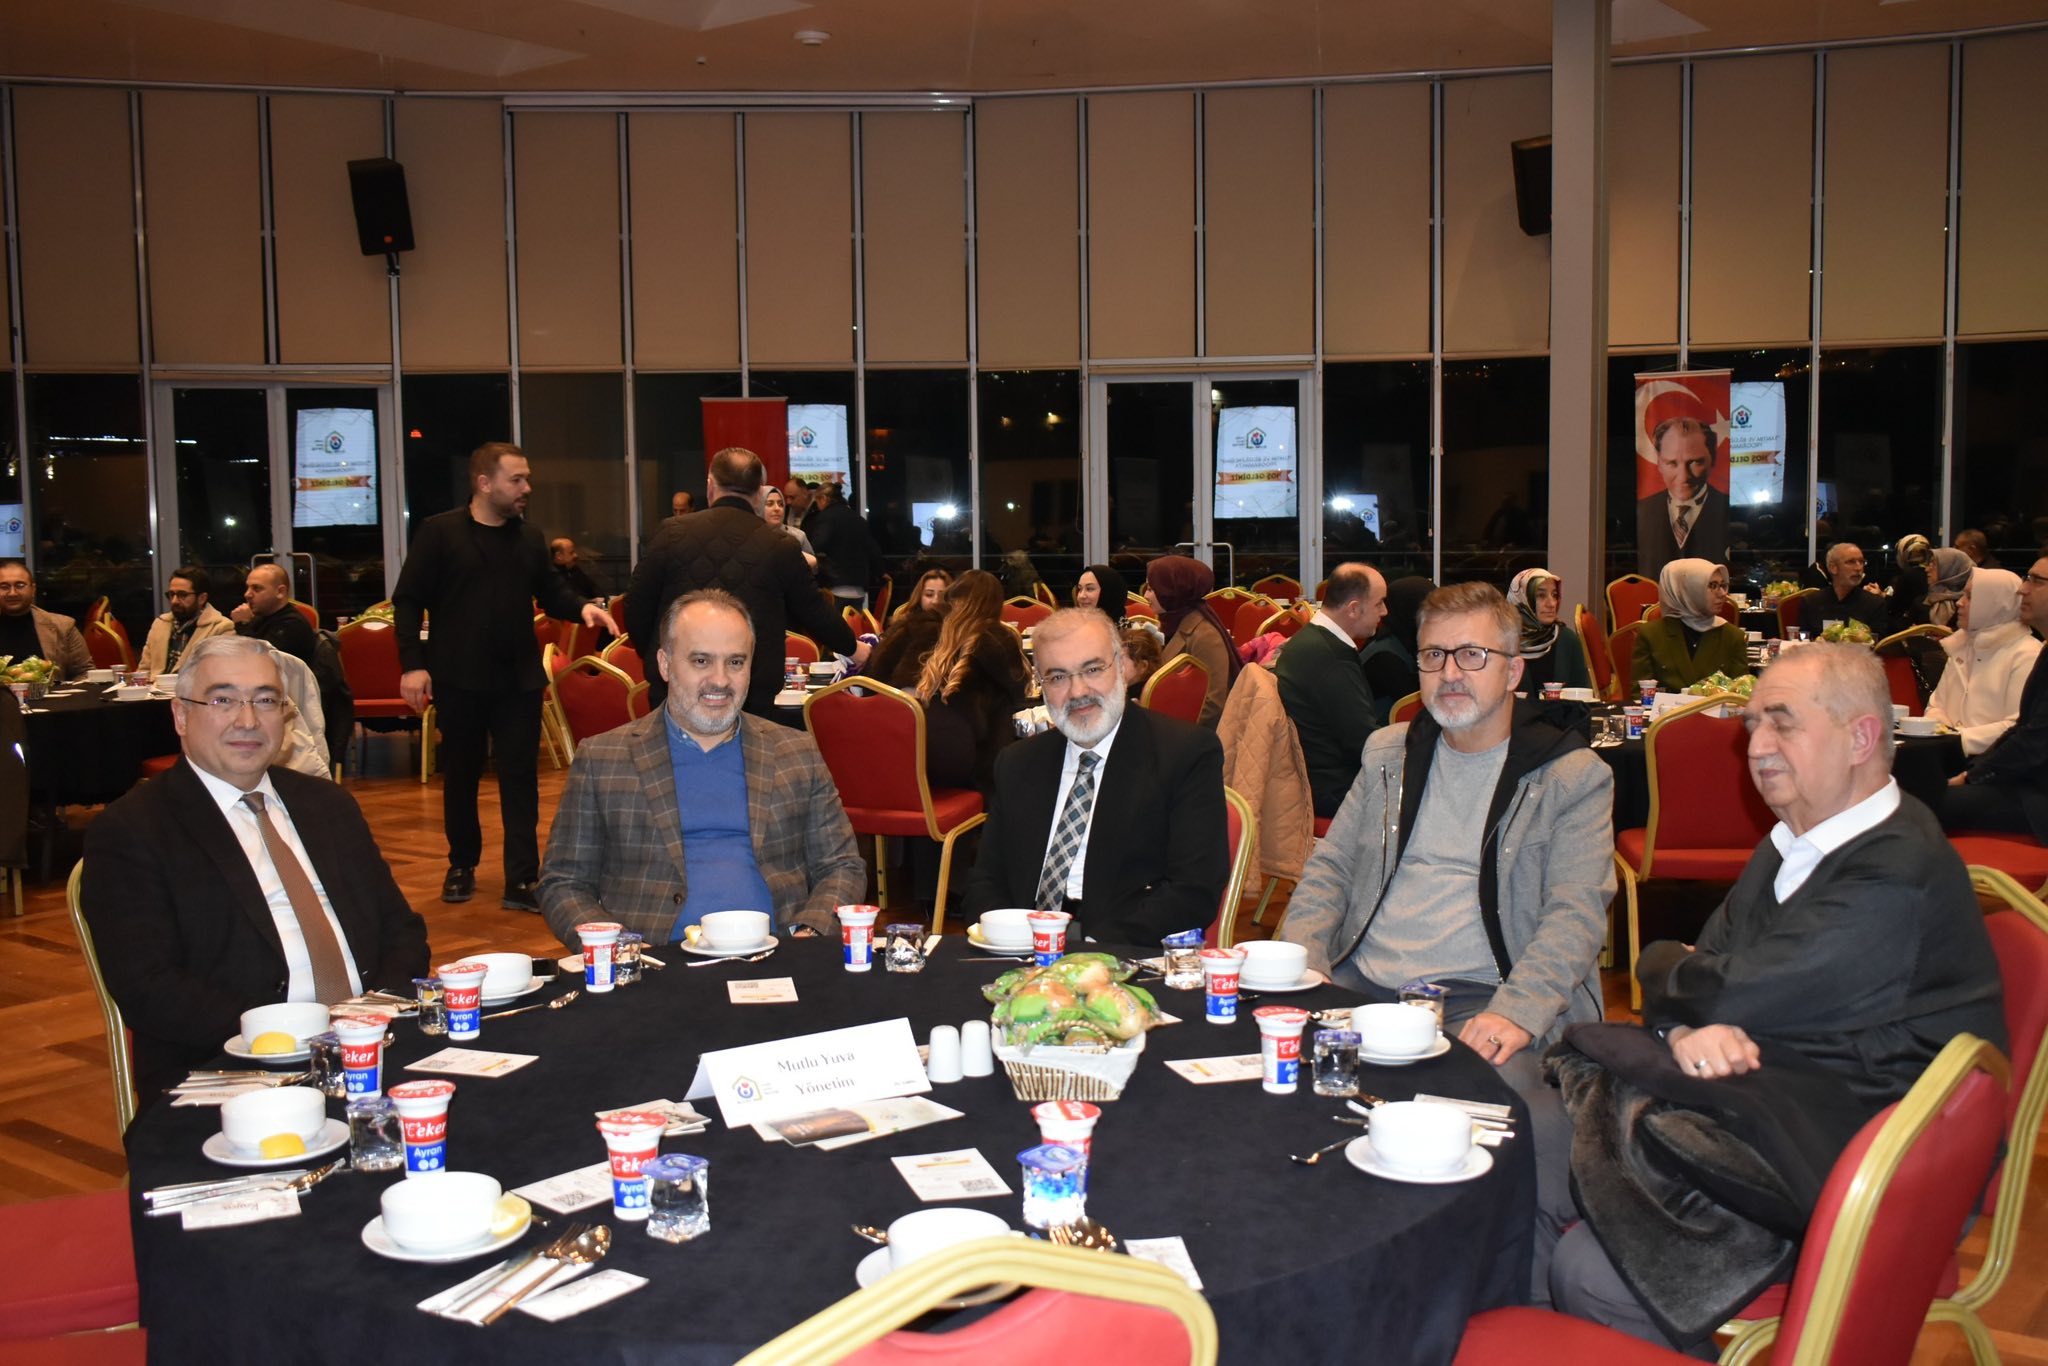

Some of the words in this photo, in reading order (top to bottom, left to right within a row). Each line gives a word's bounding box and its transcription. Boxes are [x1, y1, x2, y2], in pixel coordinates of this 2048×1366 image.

[450, 1012, 473, 1022] Ayran
[777, 1056, 819, 1073] Mutlu
[820, 1053, 856, 1067] Yuva
[795, 1076, 855, 1096] Yönetim
[414, 1145, 443, 1159] Ayran
